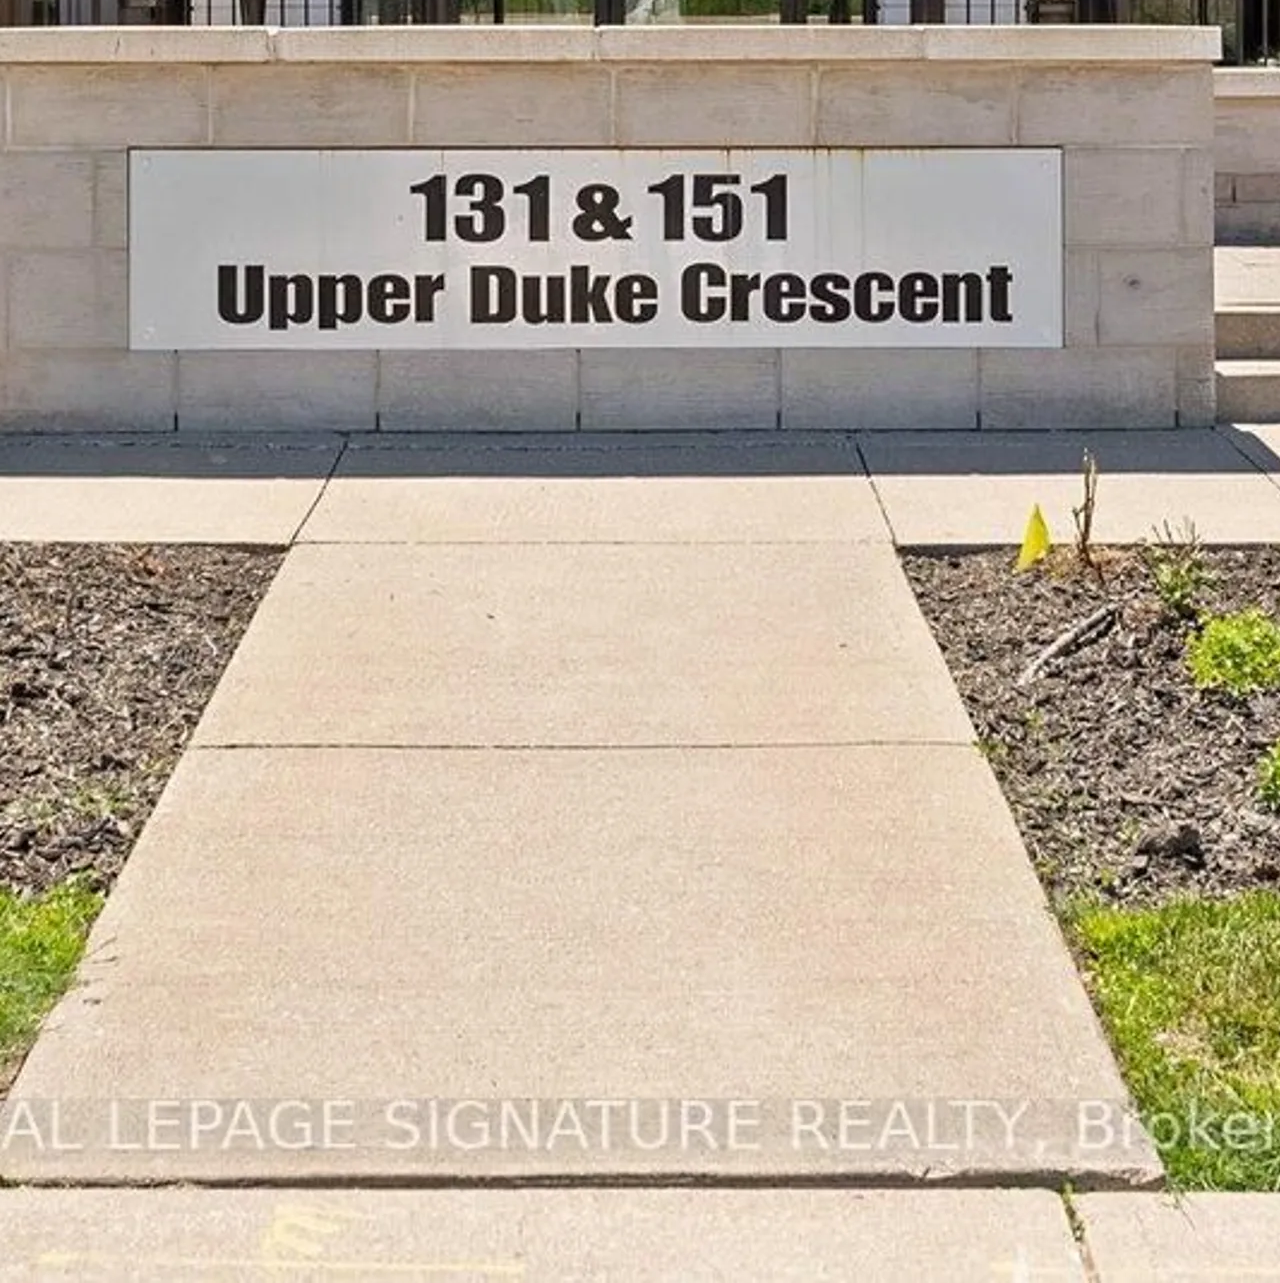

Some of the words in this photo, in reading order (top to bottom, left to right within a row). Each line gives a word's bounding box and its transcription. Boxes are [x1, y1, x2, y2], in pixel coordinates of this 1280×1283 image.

[410, 174, 550, 243] 131
[572, 183, 632, 242] &
[647, 174, 788, 242] 151
[217, 264, 445, 331] Upper
[470, 265, 658, 325] Duke
[681, 262, 1013, 324] Crescent
